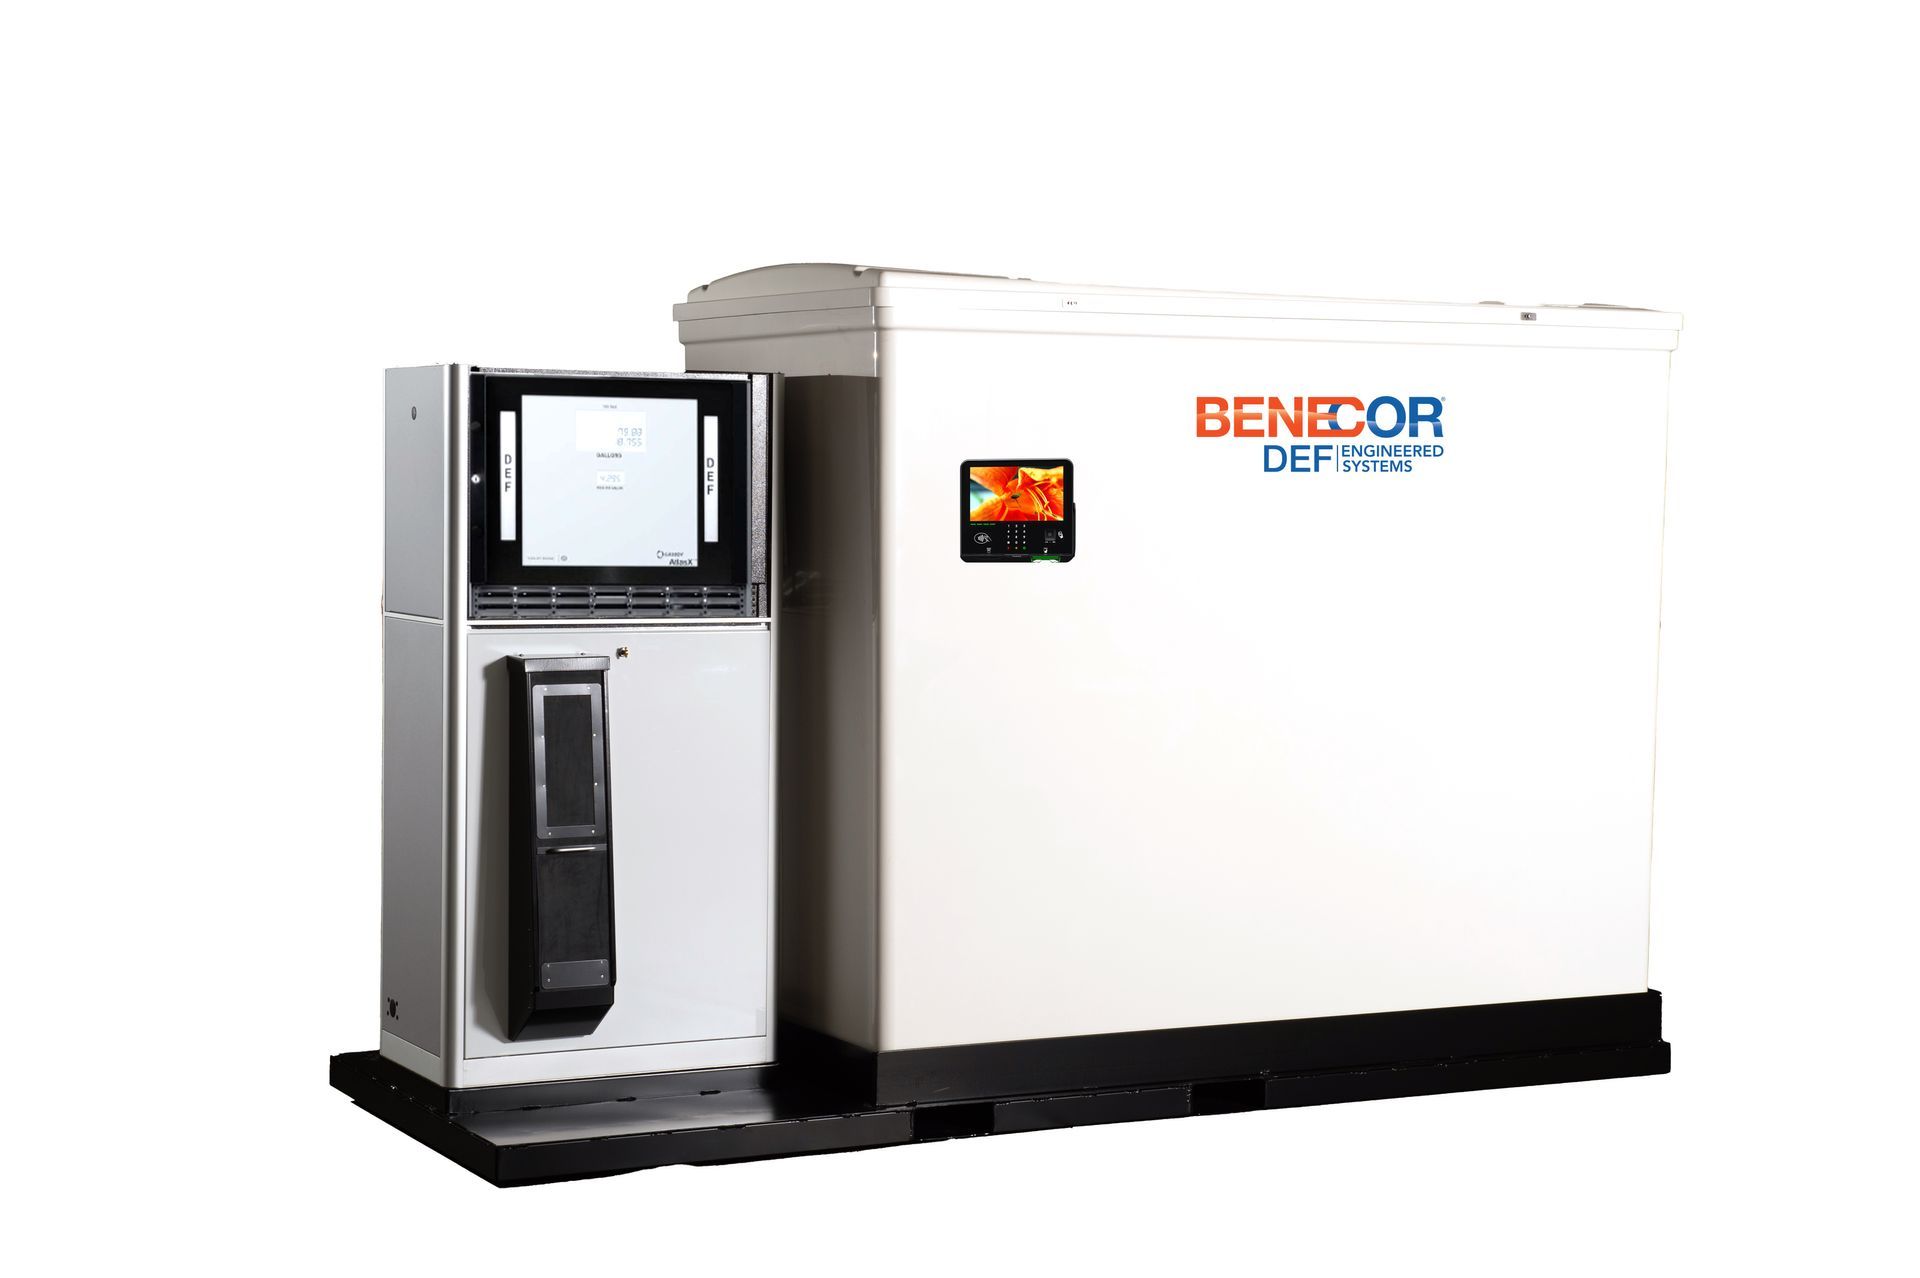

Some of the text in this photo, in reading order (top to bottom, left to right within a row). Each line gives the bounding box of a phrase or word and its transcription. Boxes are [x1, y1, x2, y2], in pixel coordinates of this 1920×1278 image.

[1196, 395, 1444, 438] BENECOR
[1263, 444, 1333, 473] DEF
[1341, 444, 1444, 457] ENGINEERED
[1342, 460, 1413, 473] SYSTEMS
[504, 454, 512, 492] DEF
[706, 458, 715, 495] DEF
